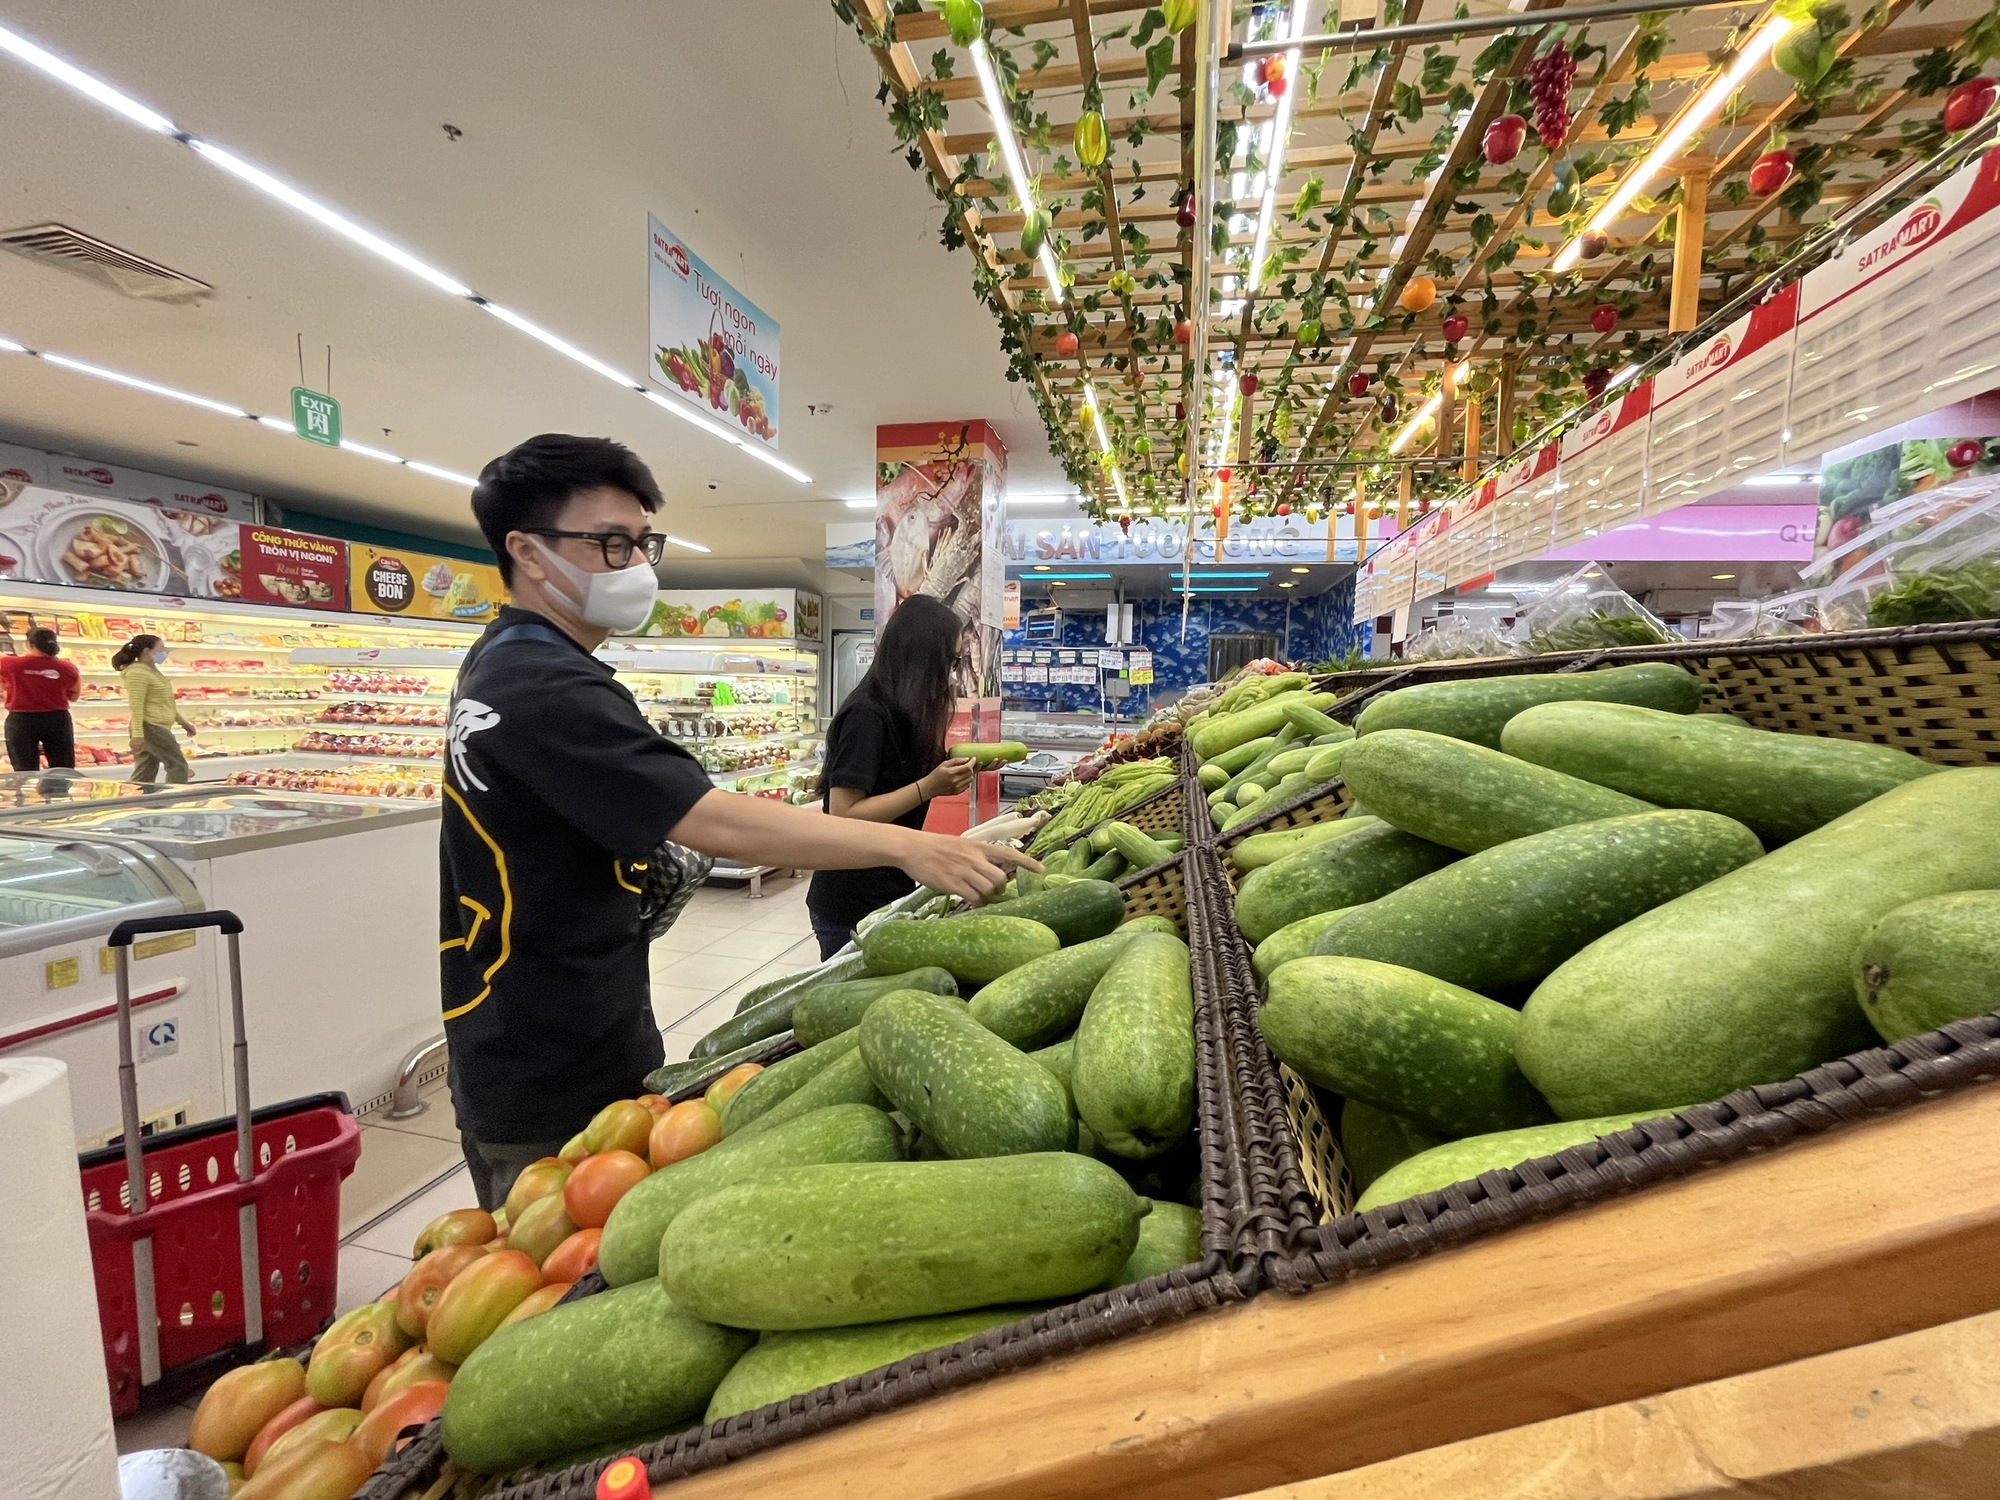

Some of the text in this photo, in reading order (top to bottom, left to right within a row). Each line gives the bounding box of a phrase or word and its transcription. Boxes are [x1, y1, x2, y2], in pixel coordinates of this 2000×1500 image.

[1858, 210, 1939, 272] SATRAMART
[693, 269, 756, 336] Tươi ngon
[750, 349, 778, 381] ngày
[301, 395, 334, 416] EXIT
[252, 531, 338, 556] CÔNG THỨC VÀNG,
[259, 544, 333, 564] TRÒN VỊ NGON!
[373, 570, 408, 586] CHEESE
[378, 582, 403, 599] BON
